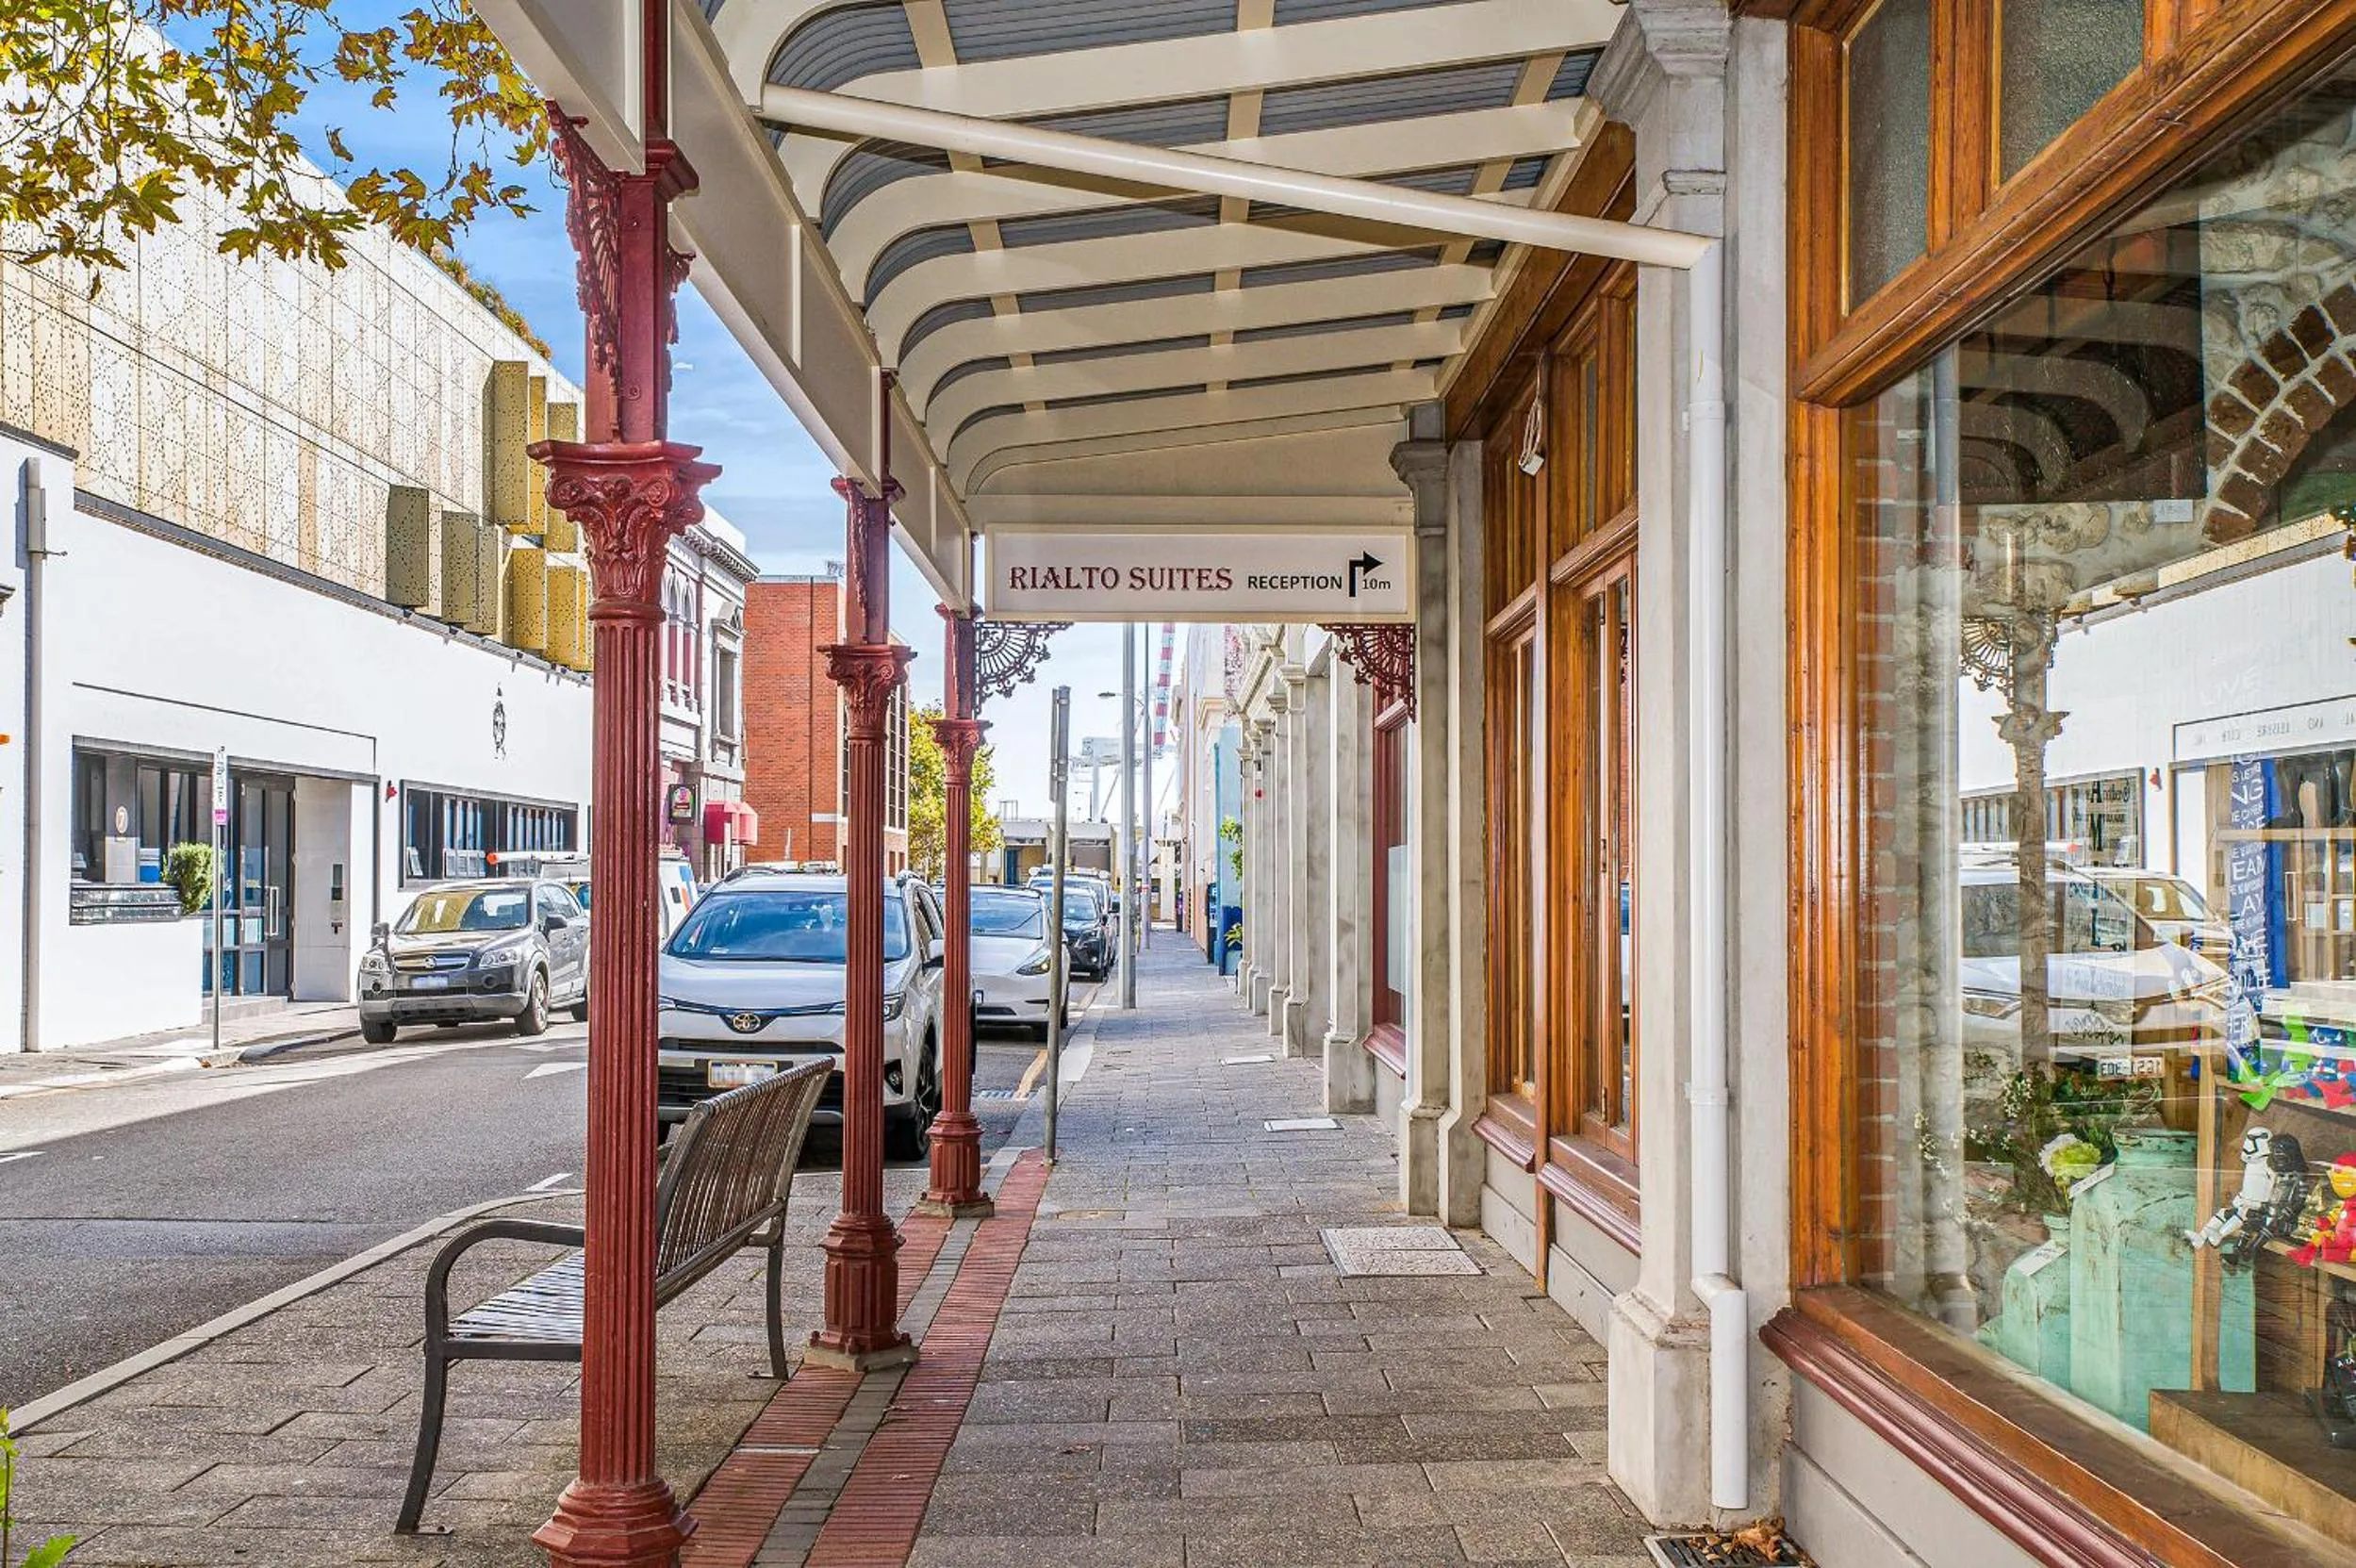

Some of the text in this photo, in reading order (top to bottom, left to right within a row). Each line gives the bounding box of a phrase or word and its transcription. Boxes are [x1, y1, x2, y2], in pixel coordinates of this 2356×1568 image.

[1009, 567, 1234, 591] RIALTO SUITES
[1247, 575, 1392, 590] RECEPTION 10m
